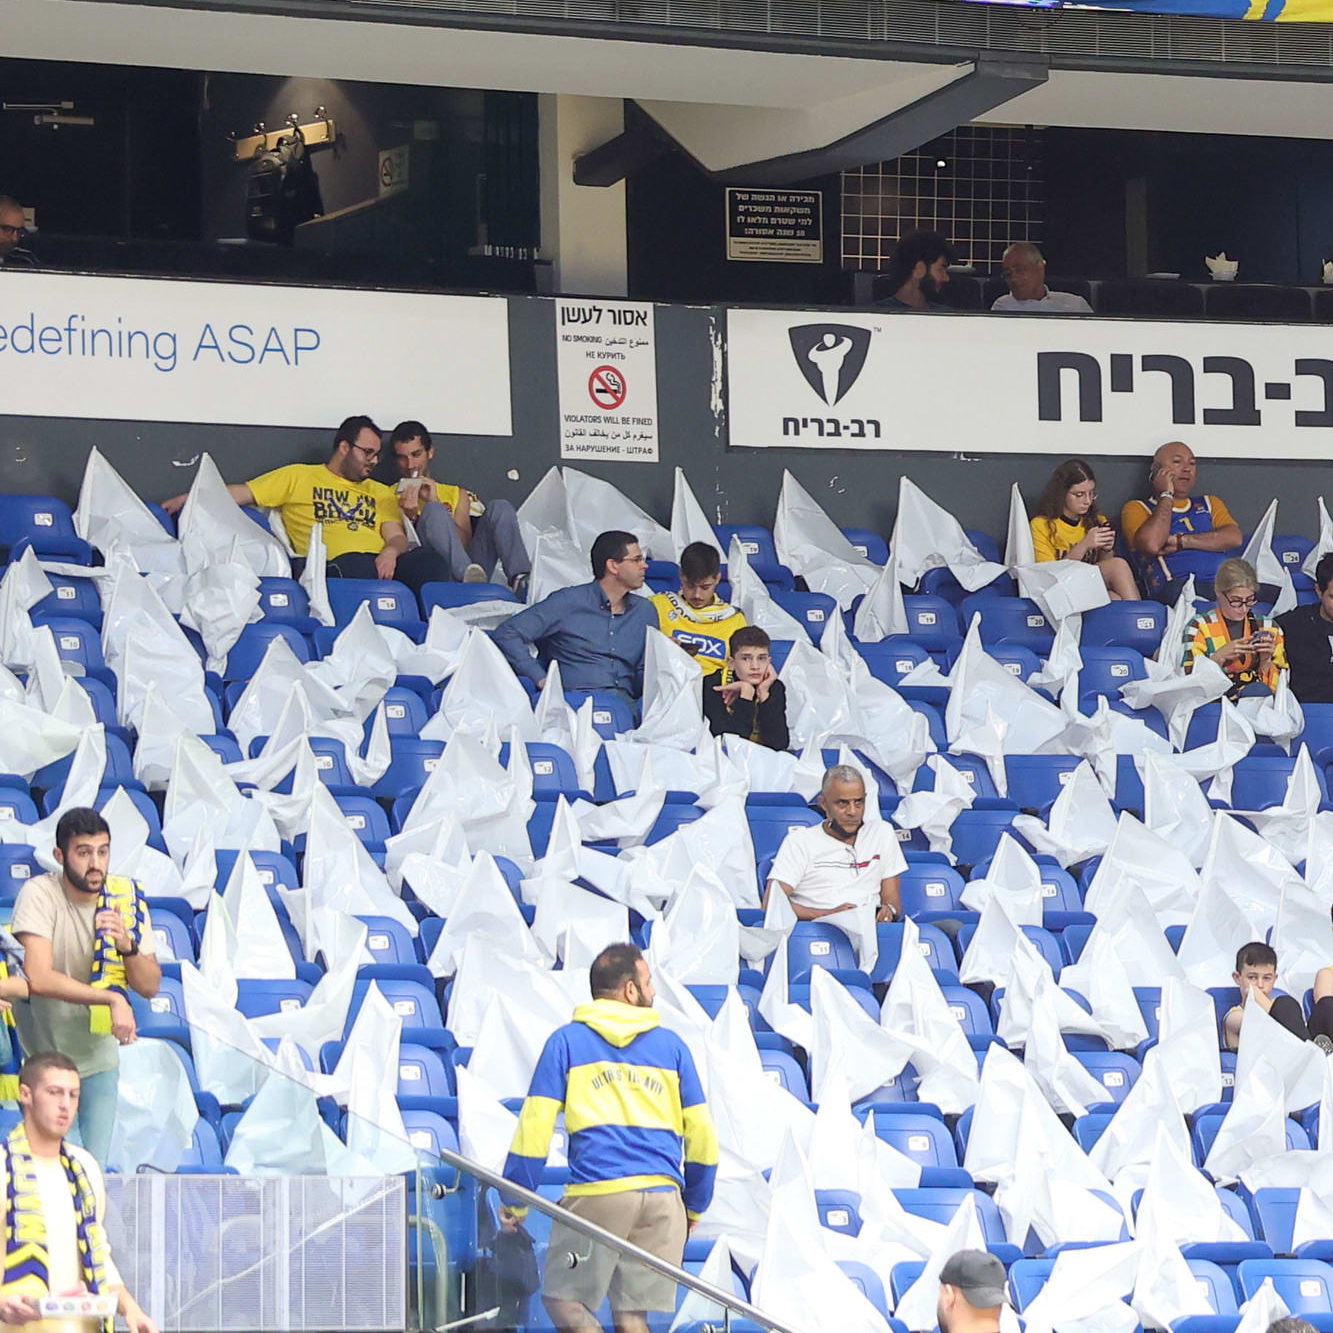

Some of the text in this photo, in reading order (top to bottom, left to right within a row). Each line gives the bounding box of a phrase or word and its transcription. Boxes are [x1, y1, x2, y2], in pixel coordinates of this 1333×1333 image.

[561, 306, 648, 326] אסור לעשן
[193, 323, 321, 365] ASAP
[573, 335, 602, 344] SMOKING
[586, 351, 626, 360] НЕ КУРИТЬ
[564, 414, 652, 426] VIOLATORS WILL BE FINED
[783, 417, 881, 438] רב-בריח
[576, 445, 620, 454] НАРУШЕНИЕ
[626, 446, 653, 455] ШТРАФ
[313, 487, 348, 503] NOW
